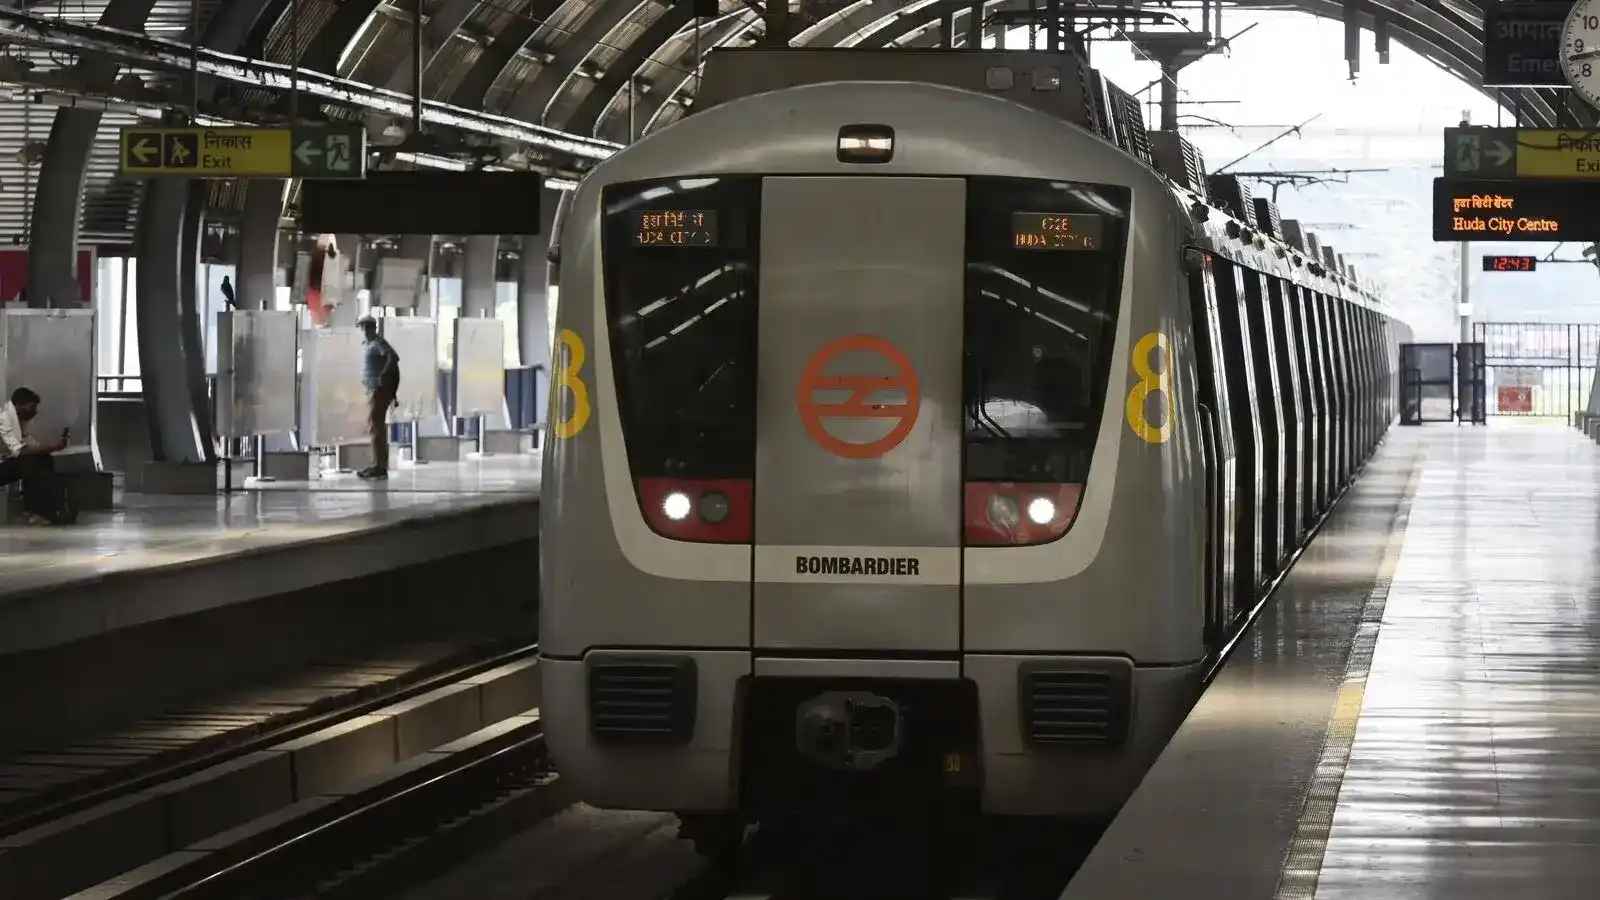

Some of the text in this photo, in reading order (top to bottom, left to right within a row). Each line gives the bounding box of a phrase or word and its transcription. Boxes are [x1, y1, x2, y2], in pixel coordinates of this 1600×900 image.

[1582, 15, 1599, 30] 10
[1574, 38, 1584, 53] 9
[1582, 63, 1592, 77] 8
[203, 131, 252, 149] निकास
[203, 154, 232, 168] Exit
[1453, 217, 1558, 234] Huda City Centre
[1493, 257, 1530, 270] 12:43
[1125, 331, 1175, 443] 8
[796, 556, 920, 575] BOMBARDIER
